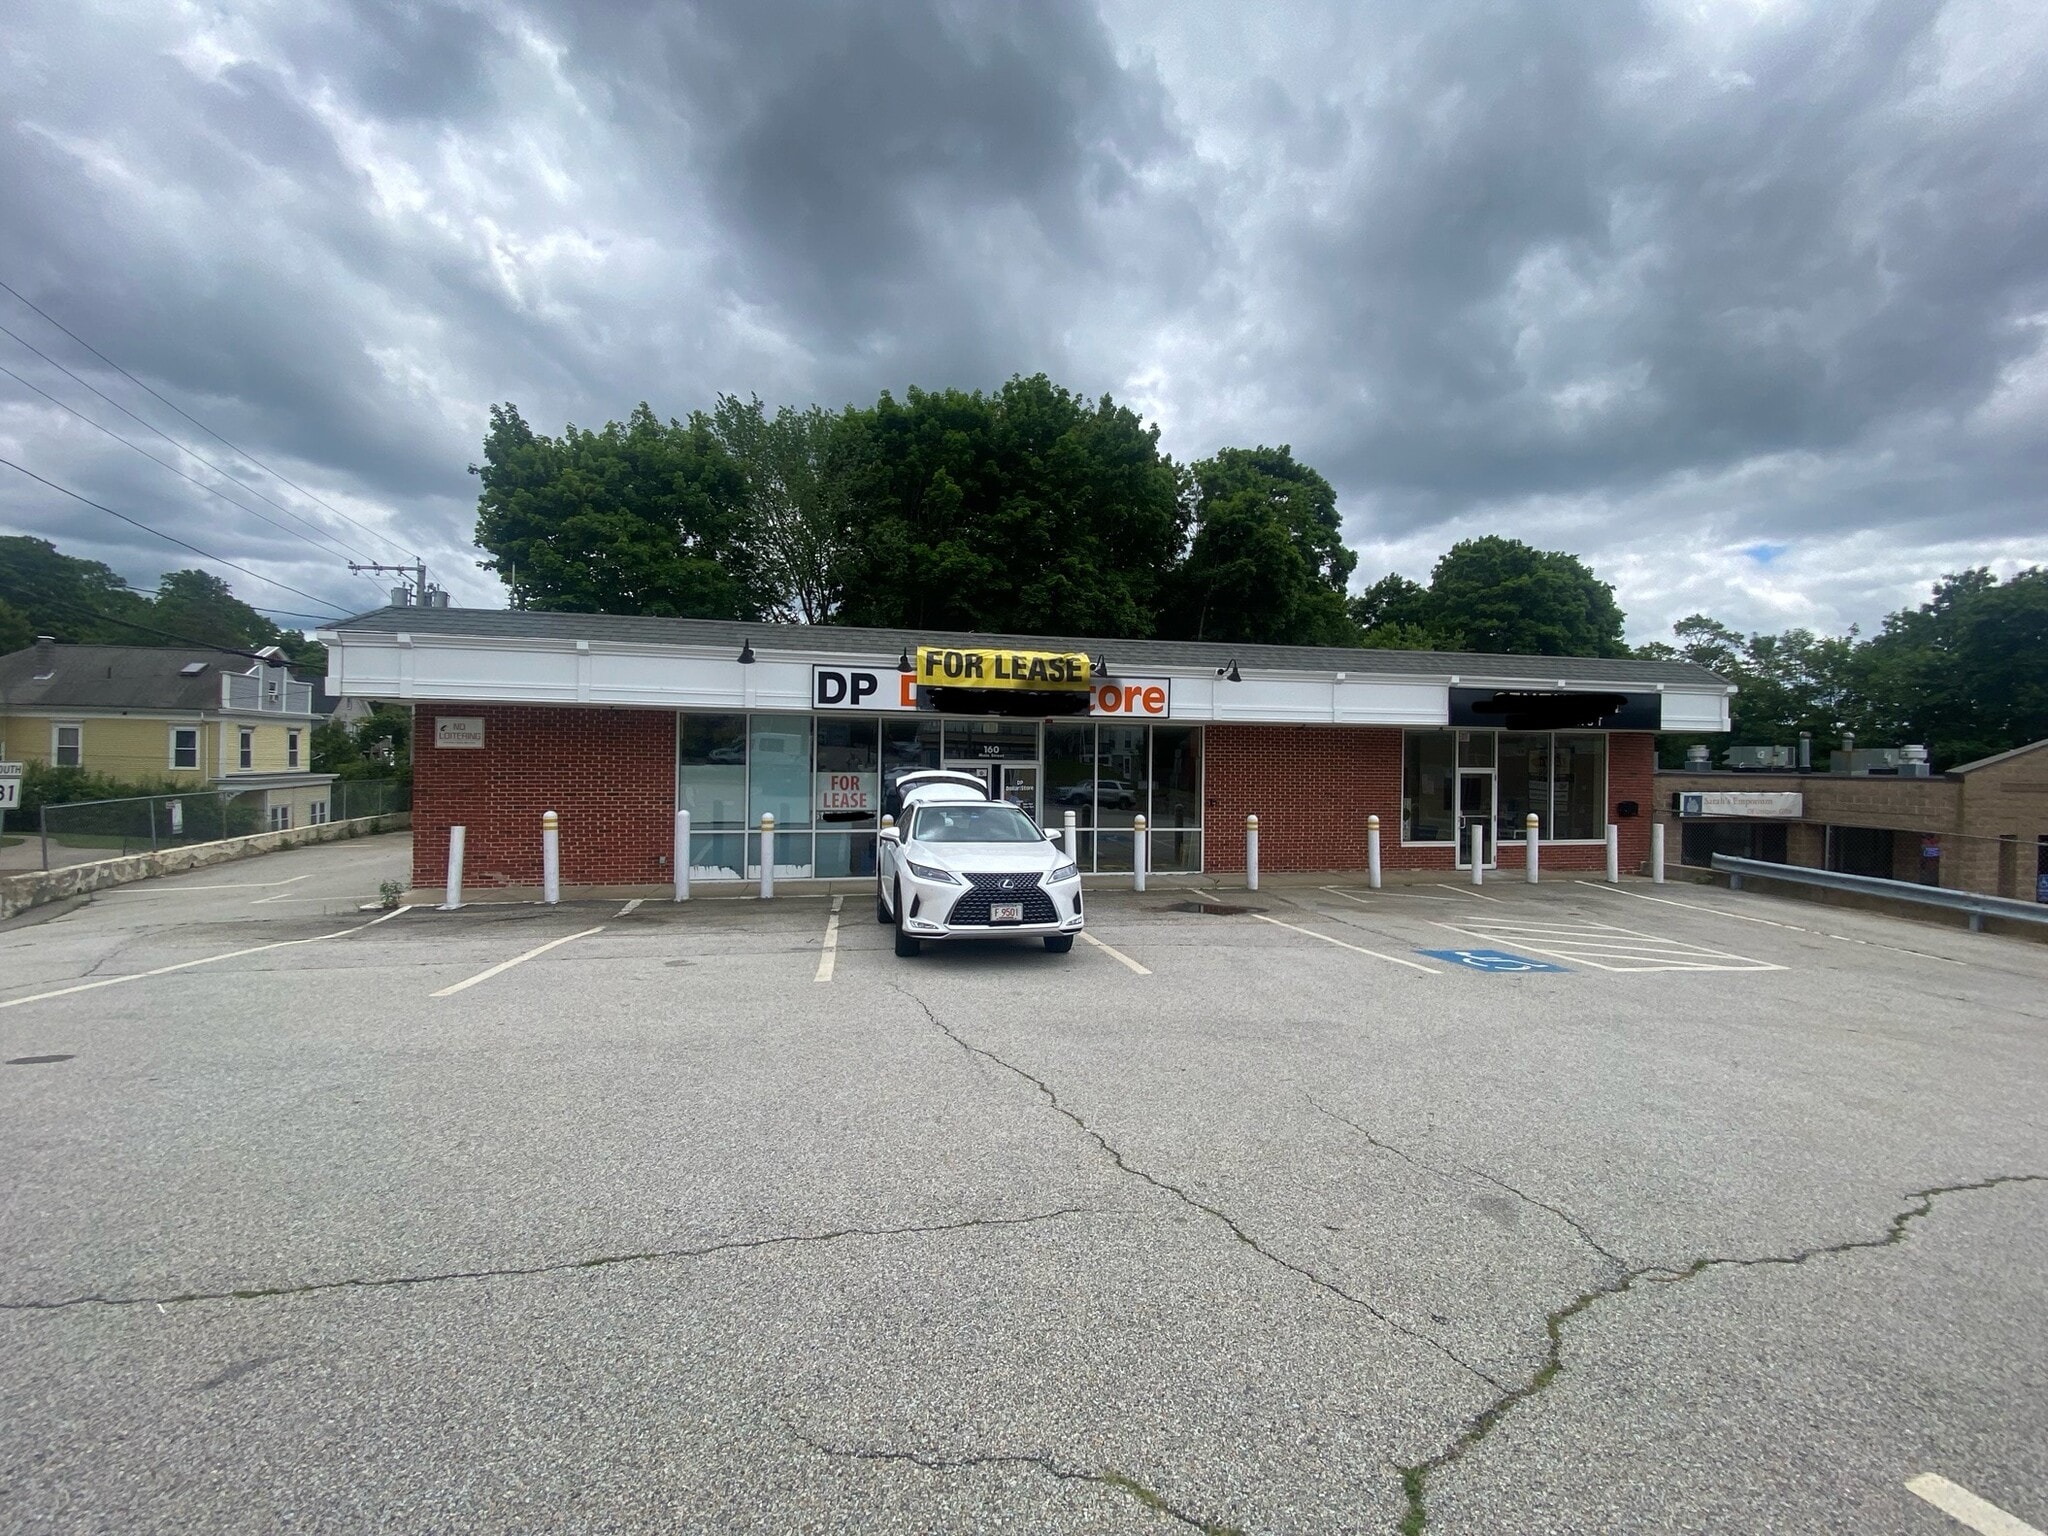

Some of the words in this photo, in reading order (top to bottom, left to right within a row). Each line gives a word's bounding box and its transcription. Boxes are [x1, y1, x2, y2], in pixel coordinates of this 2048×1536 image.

[925, 651, 984, 679] FOR
[994, 654, 1083, 683] LEASE
[818, 671, 878, 706] DP
[453, 722, 466, 731] NO
[439, 732, 481, 740] LOITERING
[983, 745, 1000, 754] 160
[831, 775, 860, 791] FOR
[823, 792, 867, 808] LEASE
[1704, 797, 1731, 805] Sarah's
[1733, 797, 1773, 807] Emporium
